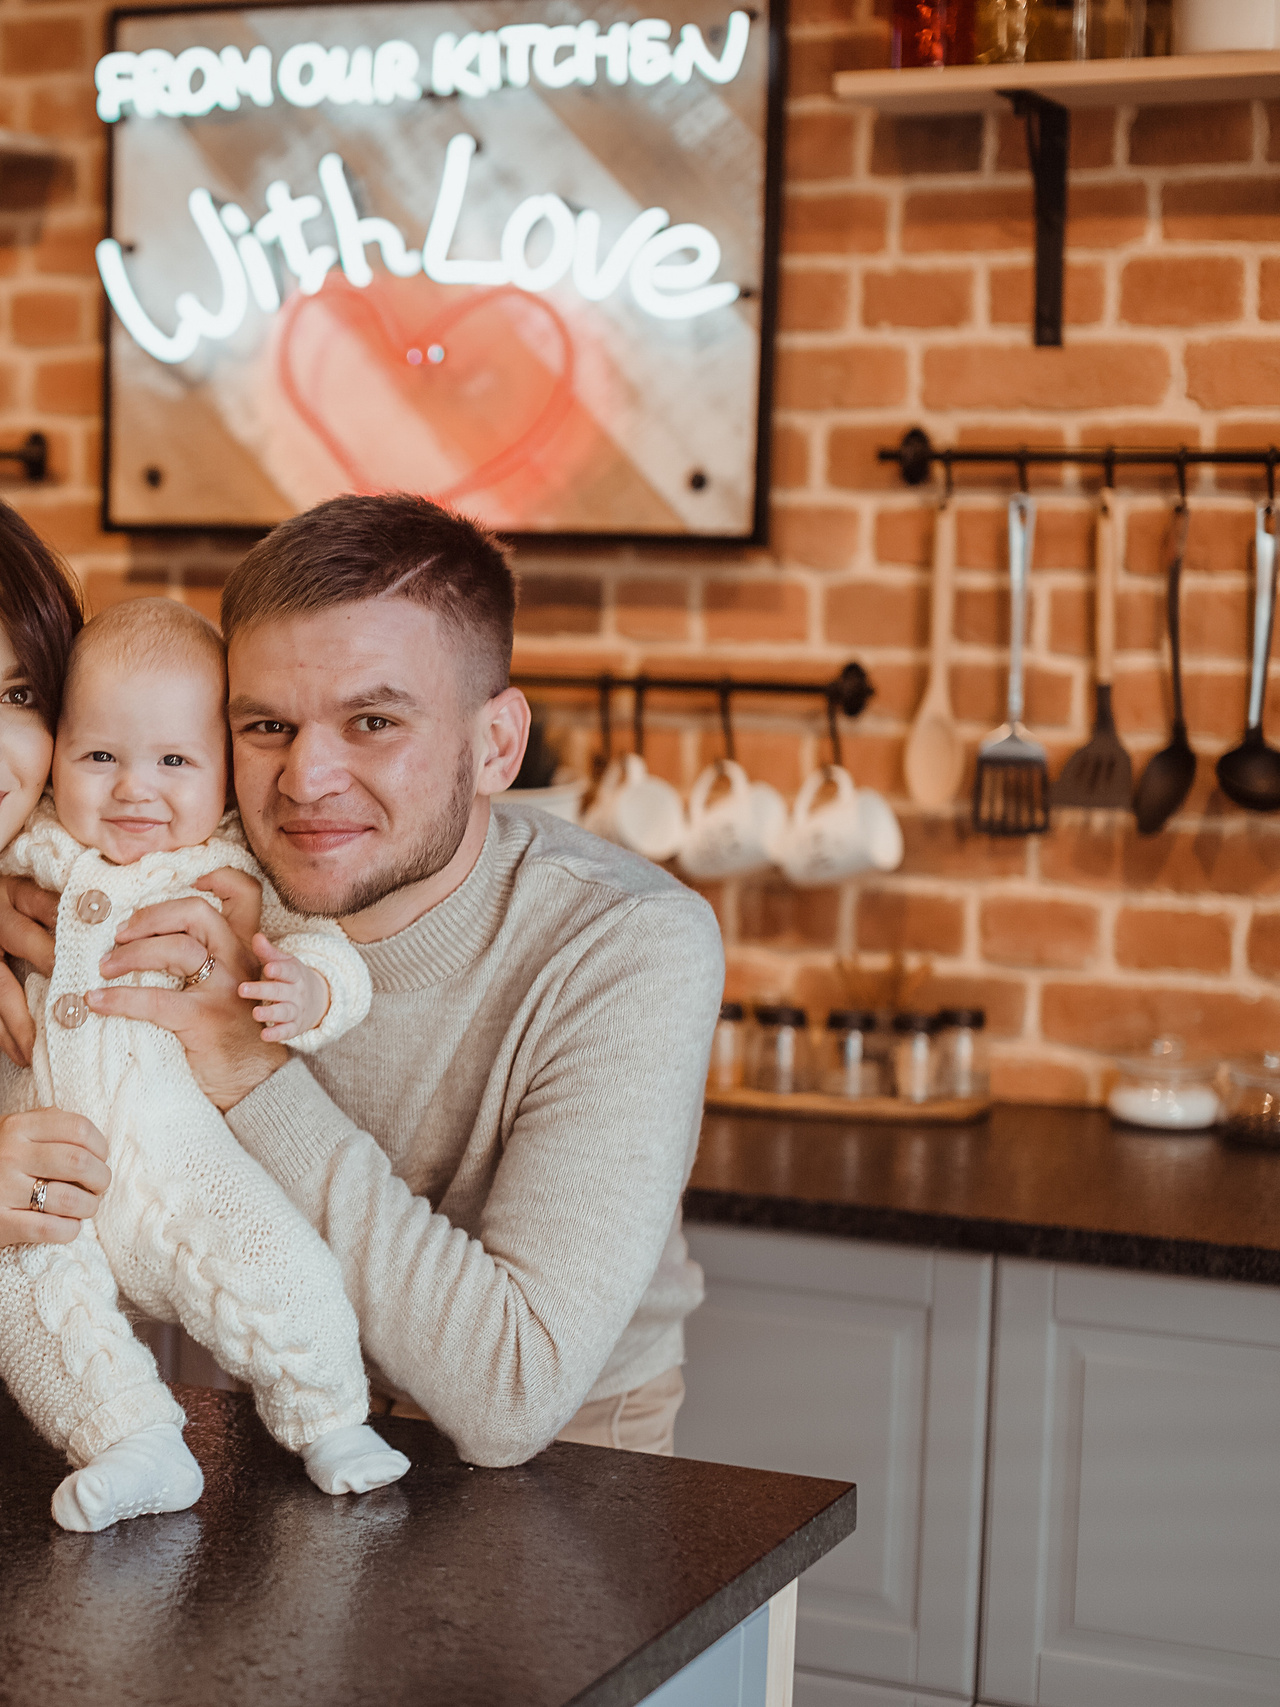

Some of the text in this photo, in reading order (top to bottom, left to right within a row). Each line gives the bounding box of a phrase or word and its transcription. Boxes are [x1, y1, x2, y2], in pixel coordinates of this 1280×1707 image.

[95, 11, 750, 122] FROM OUR KITCHEN
[95, 133, 740, 364] With Love
